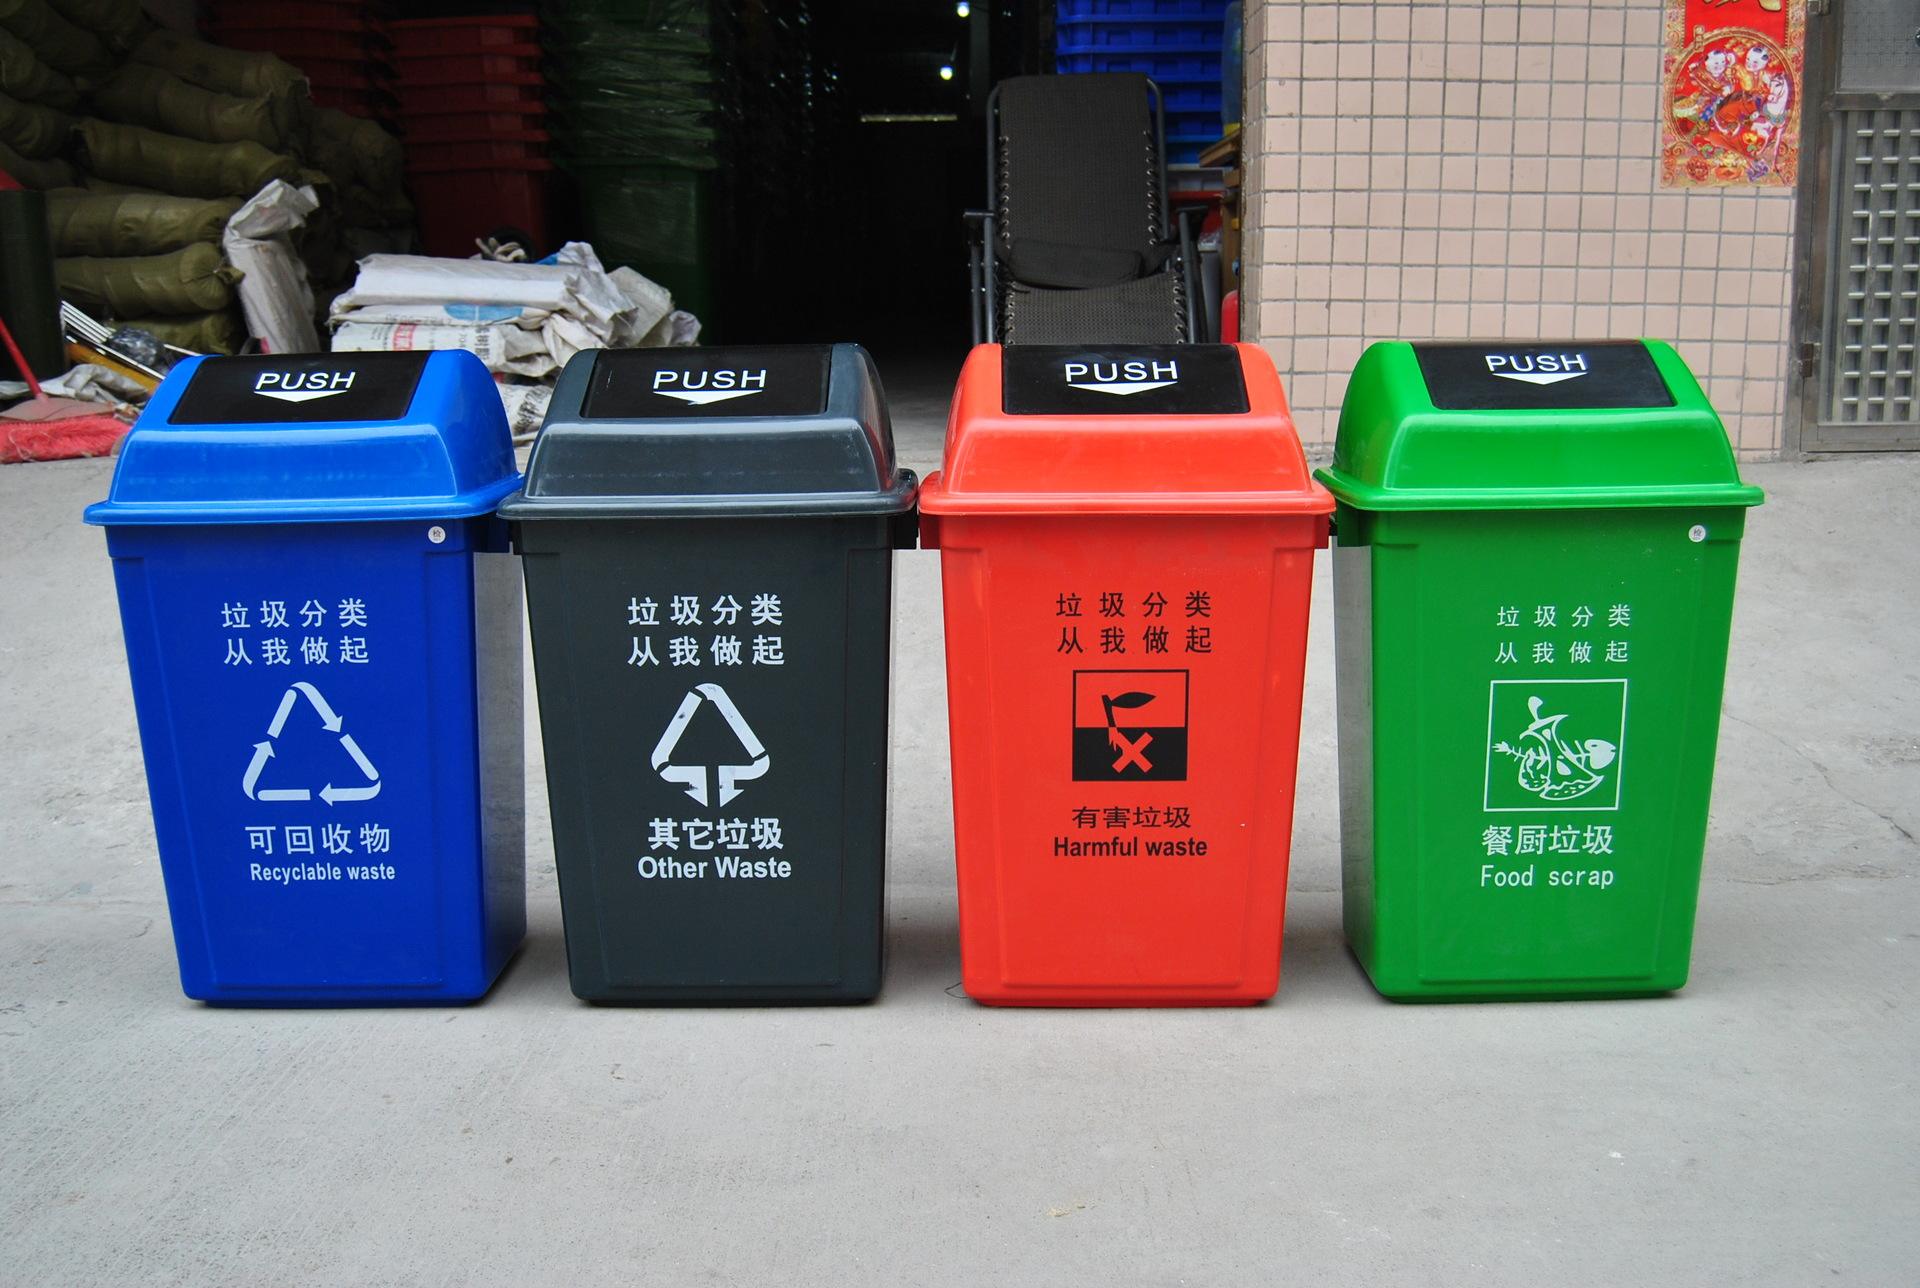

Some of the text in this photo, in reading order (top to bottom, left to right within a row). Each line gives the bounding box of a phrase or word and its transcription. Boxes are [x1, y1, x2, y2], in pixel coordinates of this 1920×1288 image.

[1064, 360, 1179, 382] PUSH
[1485, 353, 1587, 373] PUSH
[254, 370, 356, 391] PUSH
[653, 368, 766, 390] PUSH
[221, 598, 368, 629] 垃圾分类
[627, 593, 783, 626] 垃圾分类
[1056, 591, 1211, 618] 垃圾分类
[1496, 603, 1631, 628] 垃圾分类
[224, 635, 370, 667] 从我做起
[627, 634, 785, 667] 从我做起
[1056, 625, 1212, 655] 从我做起
[1494, 640, 1628, 664] 从我做起
[1071, 806, 1191, 829] 有害垃圾
[244, 823, 390, 855] 可回收物
[647, 817, 784, 851] 其它垃圾
[1053, 836, 1208, 857] Harmful waste
[1481, 824, 1614, 856] 餐厨垃圾
[250, 862, 396, 885] Recyclable waste
[637, 856, 792, 879] Other Waste
[1480, 864, 1614, 890] Food scrap
